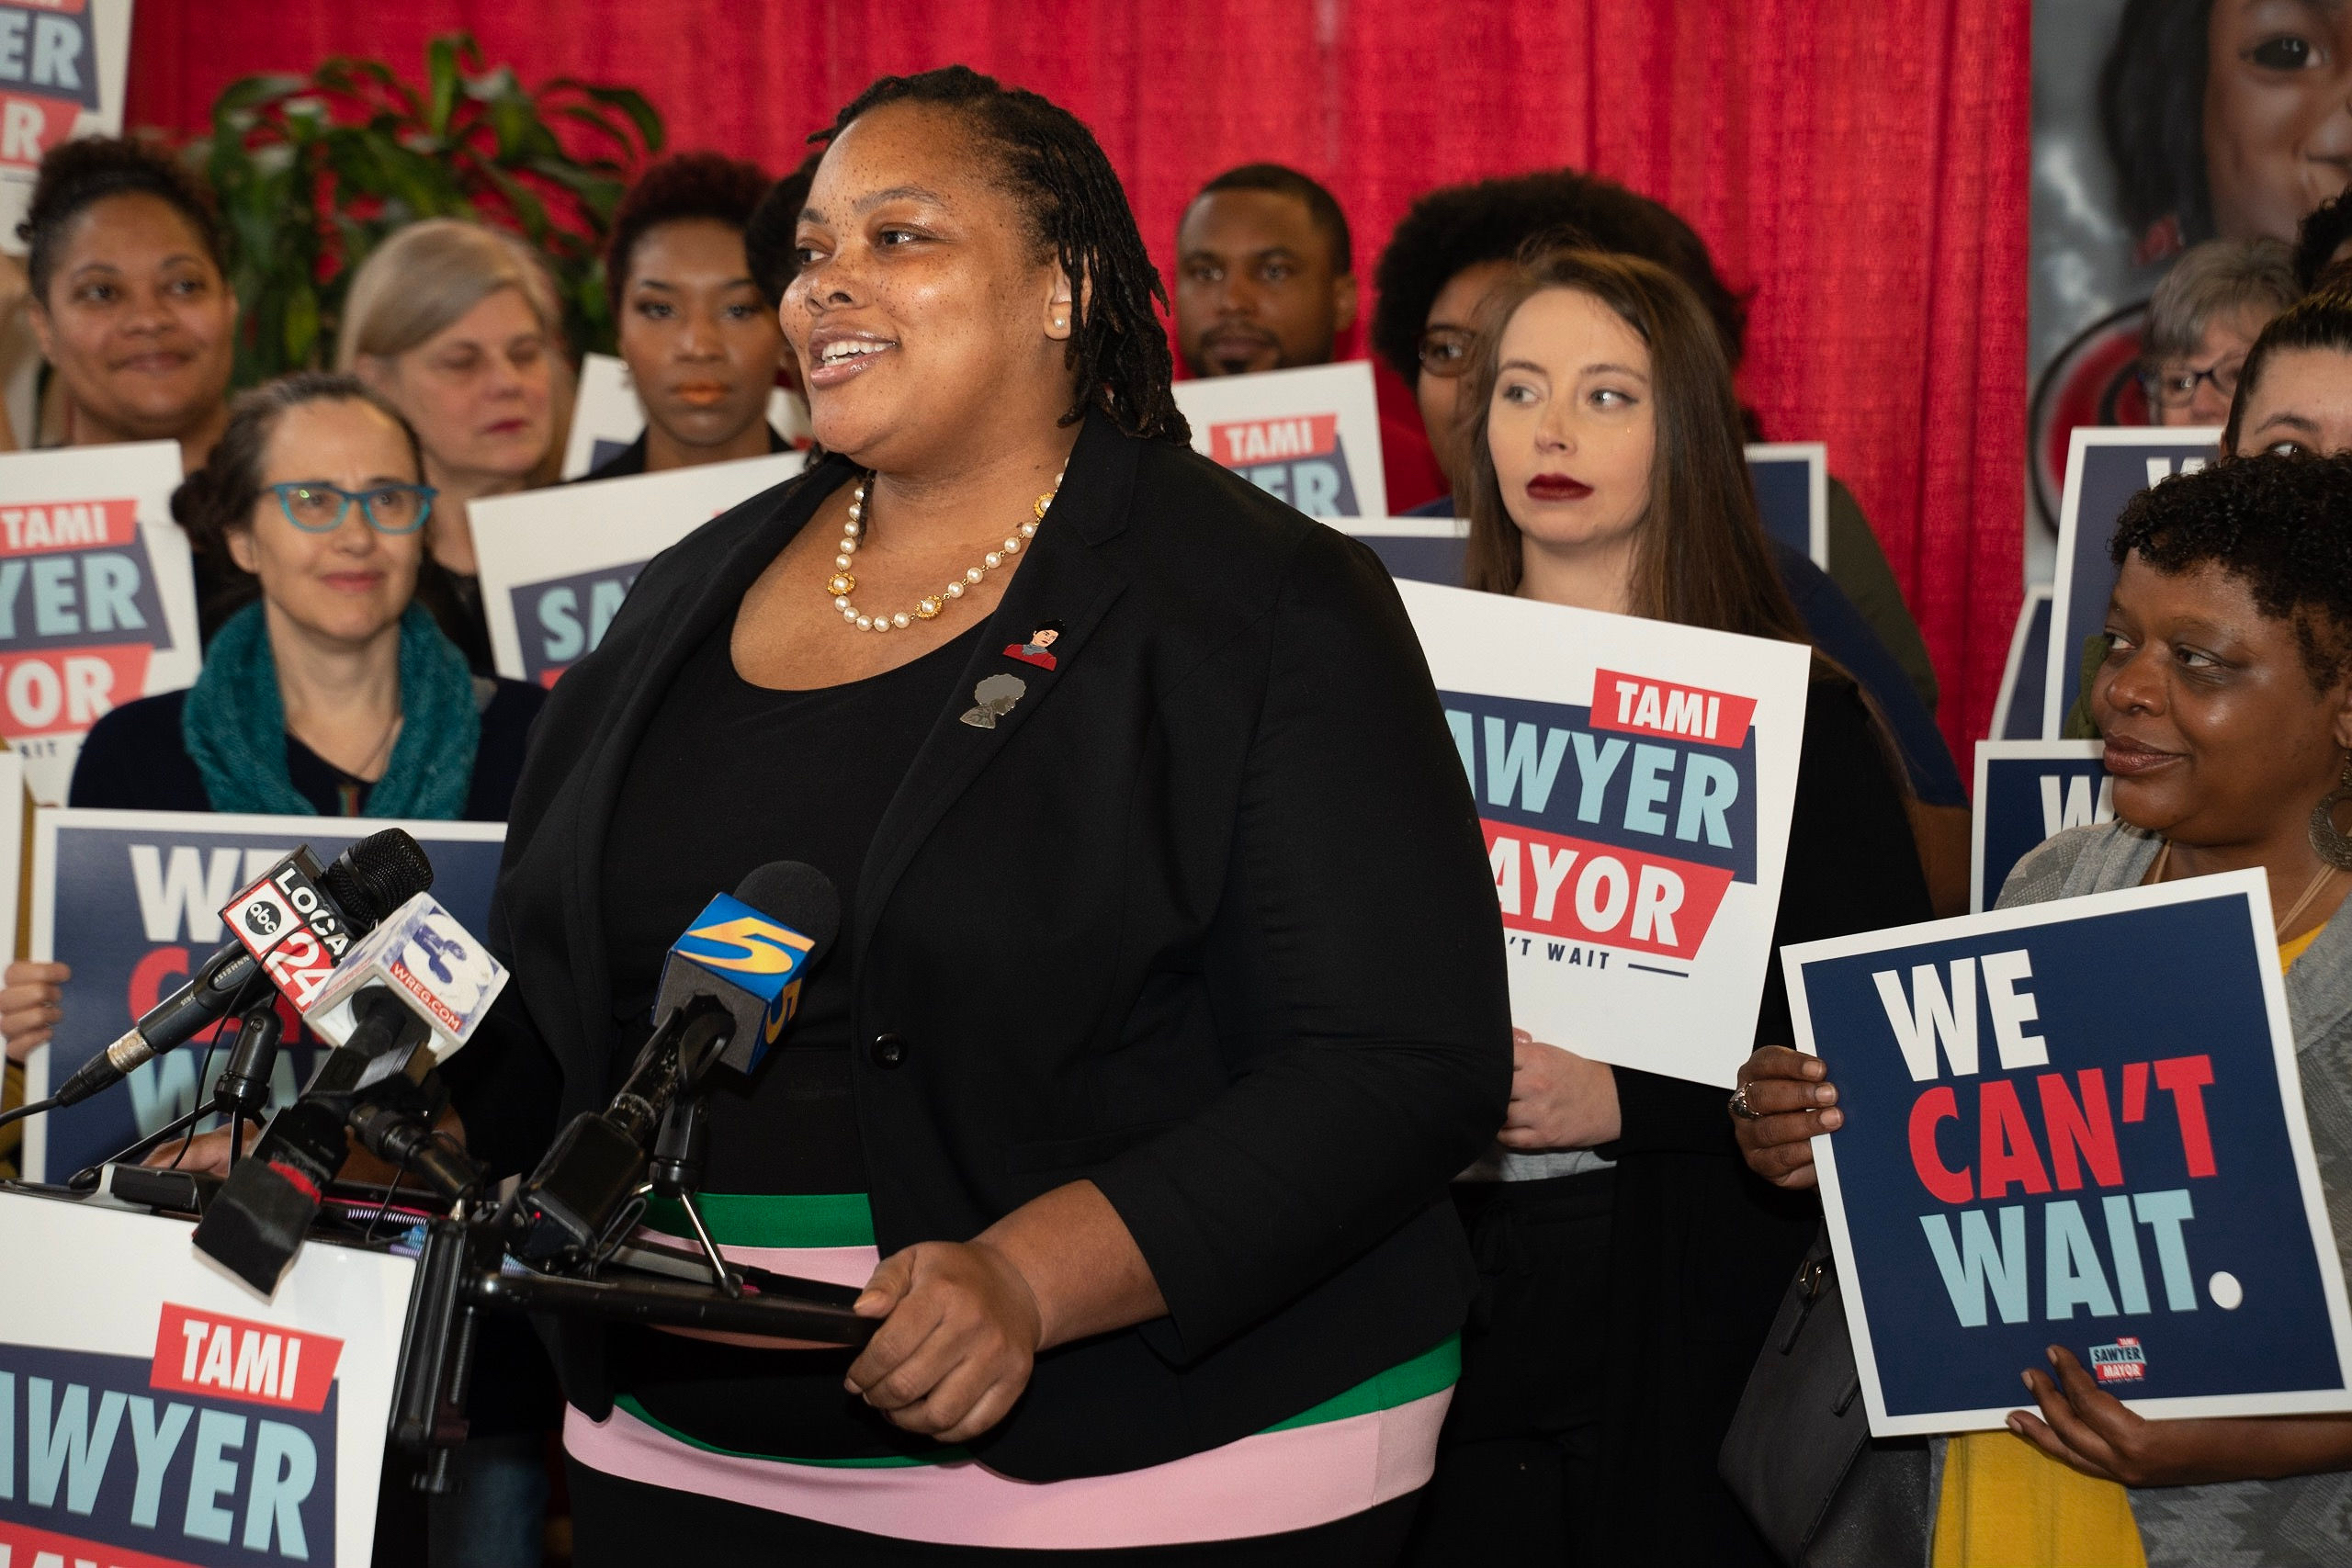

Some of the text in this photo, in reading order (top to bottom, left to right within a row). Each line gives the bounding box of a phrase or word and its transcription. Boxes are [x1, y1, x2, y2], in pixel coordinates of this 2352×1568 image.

[1225, 418, 1315, 462] TAMI
[1, 503, 108, 548] TAMI
[0, 656, 115, 728] OR
[1615, 681, 1720, 739] TAMI
[249, 903, 277, 933] abc
[275, 867, 349, 963] LOCA
[675, 916, 816, 975] 5
[260, 931, 336, 1007] 24
[1547, 942, 1610, 970] WAIT
[392, 963, 460, 1031] WREG.COM
[1872, 948, 2051, 1082] WE
[1907, 1054, 2218, 1205] CAN'T
[1918, 1189, 2244, 1328] WAIT.
[182, 1318, 302, 1401] TAMI
[2094, 1348, 2142, 1361] SAWYER
[2103, 1363, 2142, 1377] MAYOR
[0, 1371, 319, 1560] WYER
